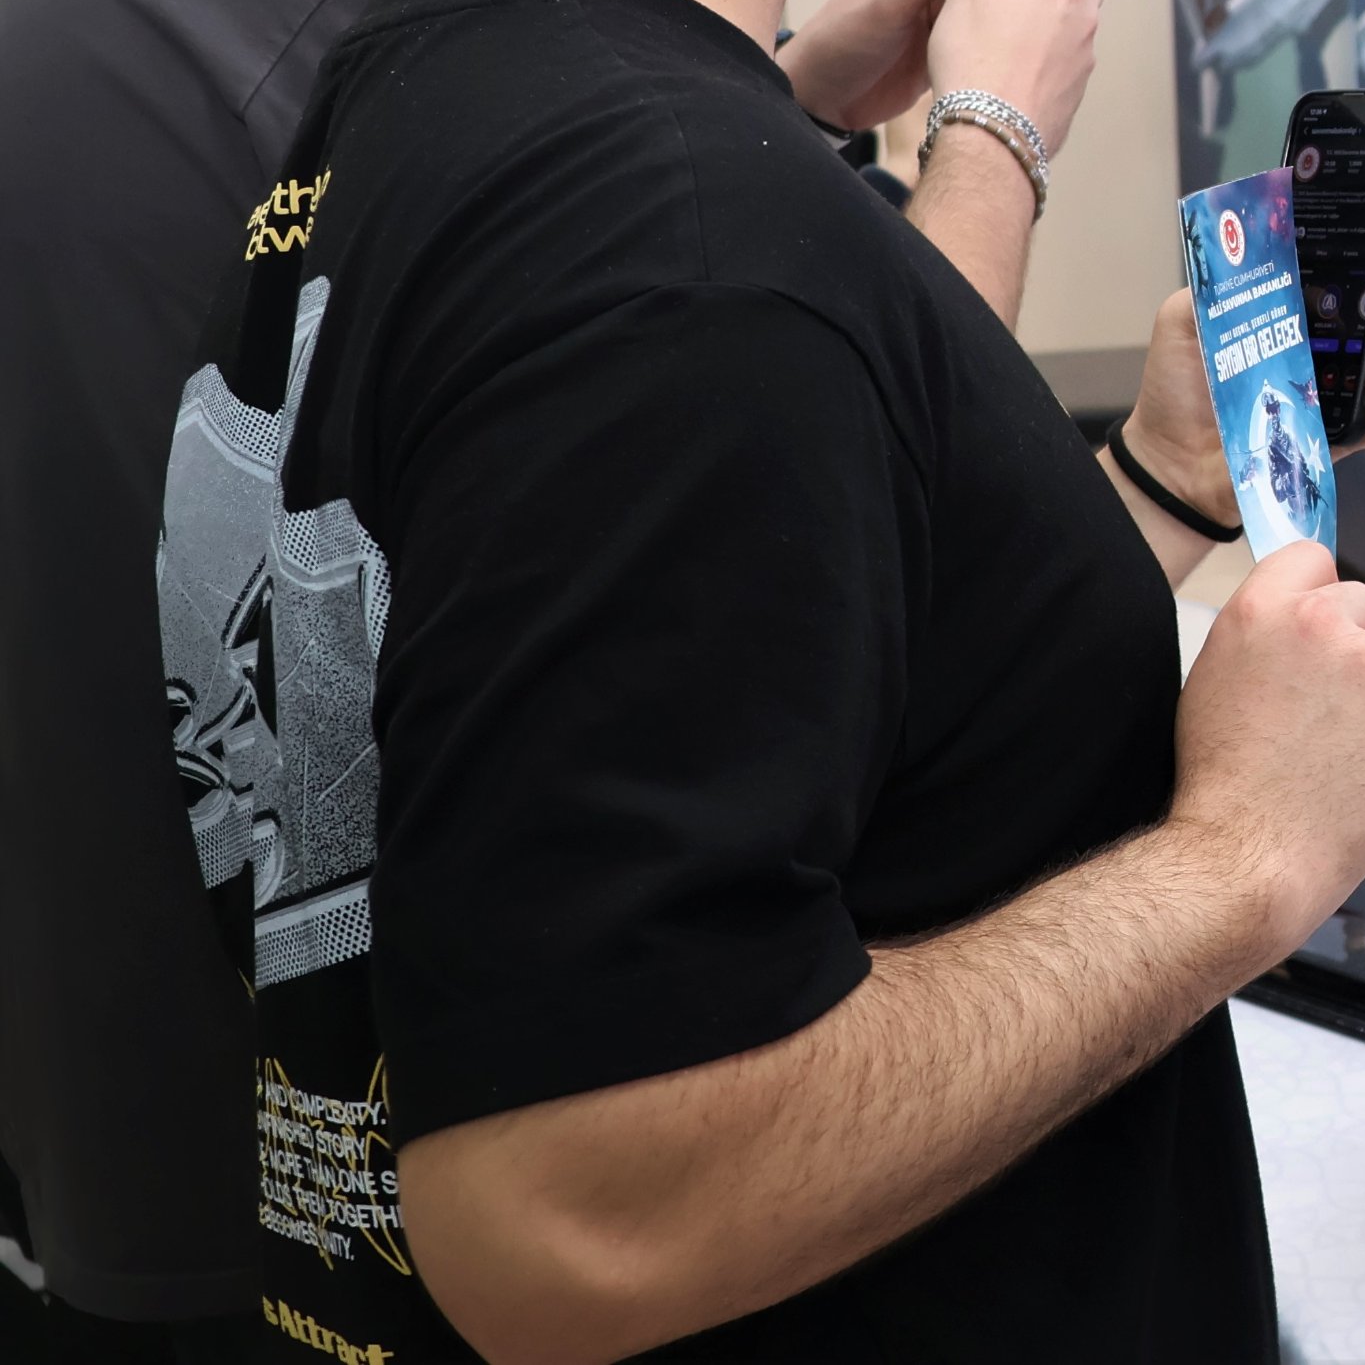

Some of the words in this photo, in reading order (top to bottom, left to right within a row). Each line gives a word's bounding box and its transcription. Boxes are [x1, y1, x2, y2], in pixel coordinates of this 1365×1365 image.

[1222, 289, 1253, 313] SAVUNMA
[1252, 271, 1292, 299] BAKANLIĞI
[1214, 340, 1248, 383] SAYGIN
[1241, 334, 1262, 369] BİR
[1257, 314, 1304, 360] GELECEK
[266, 1081, 288, 1108] AND
[289, 1086, 387, 1126] COMPLEXITY.
[315, 1129, 366, 1161] STORY
[269, 1145, 304, 1179] MORE
[303, 1156, 336, 1189] THAN
[338, 1168, 379, 1195] ONE
[381, 1170, 399, 1195] S
